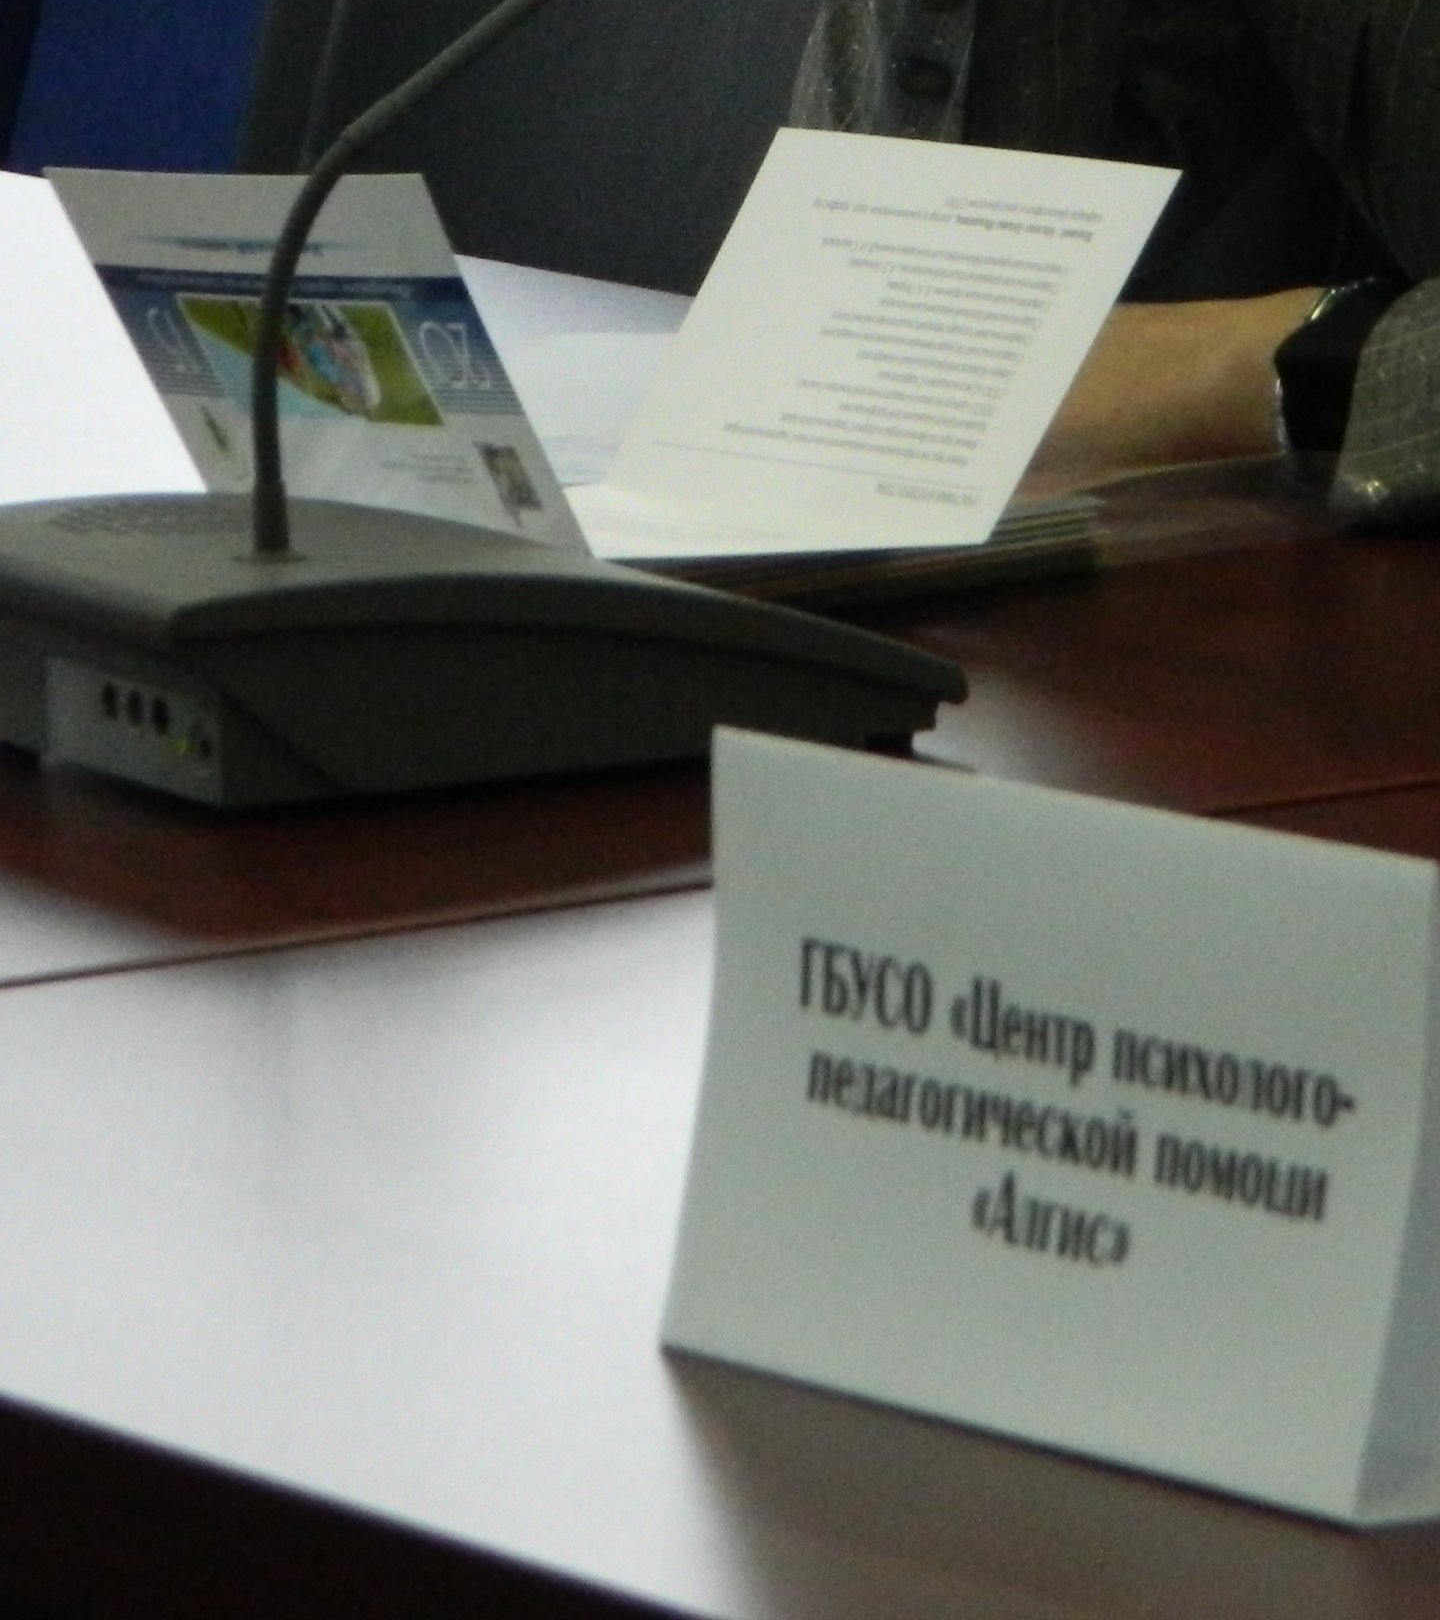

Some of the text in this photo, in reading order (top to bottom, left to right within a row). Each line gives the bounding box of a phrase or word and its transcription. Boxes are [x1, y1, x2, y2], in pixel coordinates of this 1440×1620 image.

[799, 936, 1357, 1128] ГБУСО «Центр психолого-
[806, 1049, 1329, 1223] педагогической помощи
